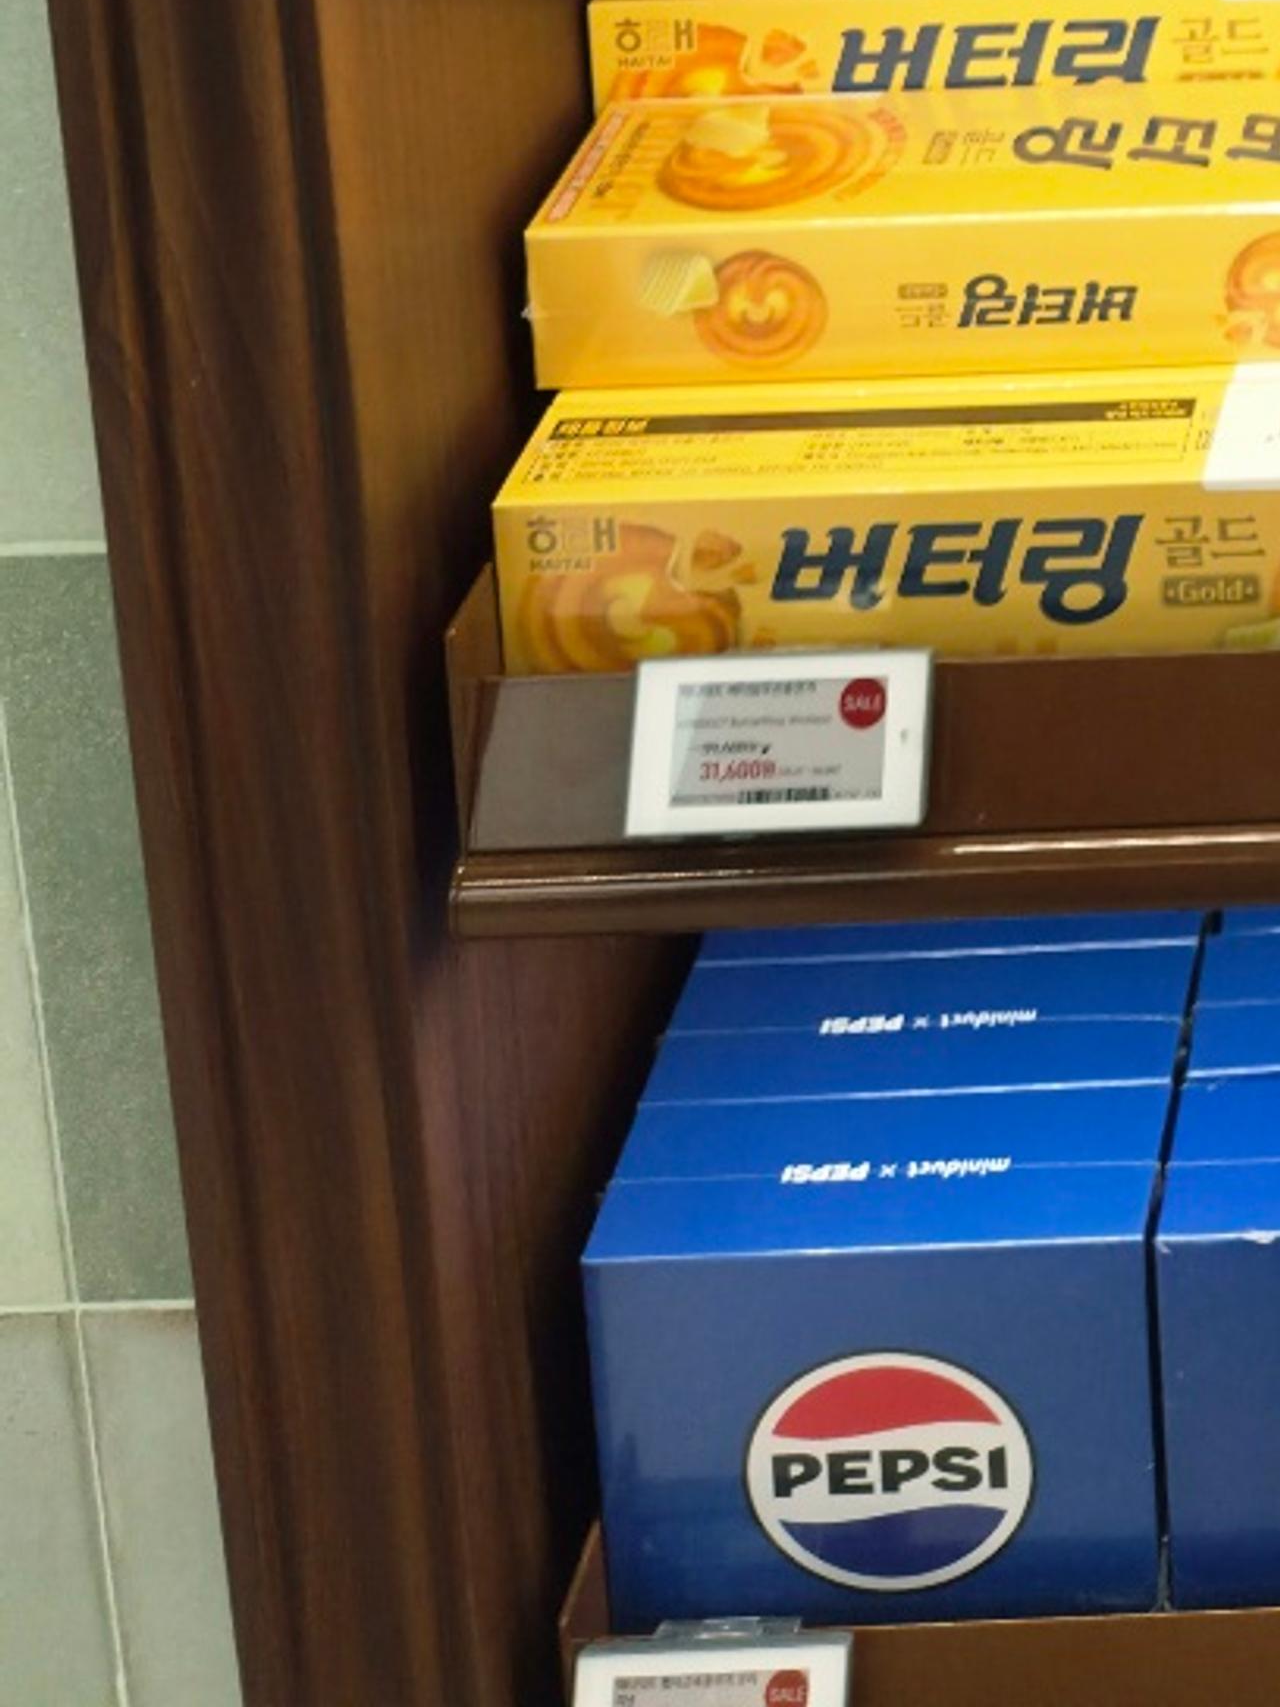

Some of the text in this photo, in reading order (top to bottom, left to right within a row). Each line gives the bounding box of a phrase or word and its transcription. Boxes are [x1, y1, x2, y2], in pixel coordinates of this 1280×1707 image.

[1172, 17, 1269, 63] 골드
[527, 516, 616, 557] 해태
[1154, 514, 1267, 565] 골드
[770, 514, 1147, 626] 버터링
[843, 694, 882, 712] SALE
[819, 1011, 905, 1036] PEPSI
[780, 1155, 1011, 1185] miniduct PEPSI
[771, 1445, 1009, 1498] PEPSI
